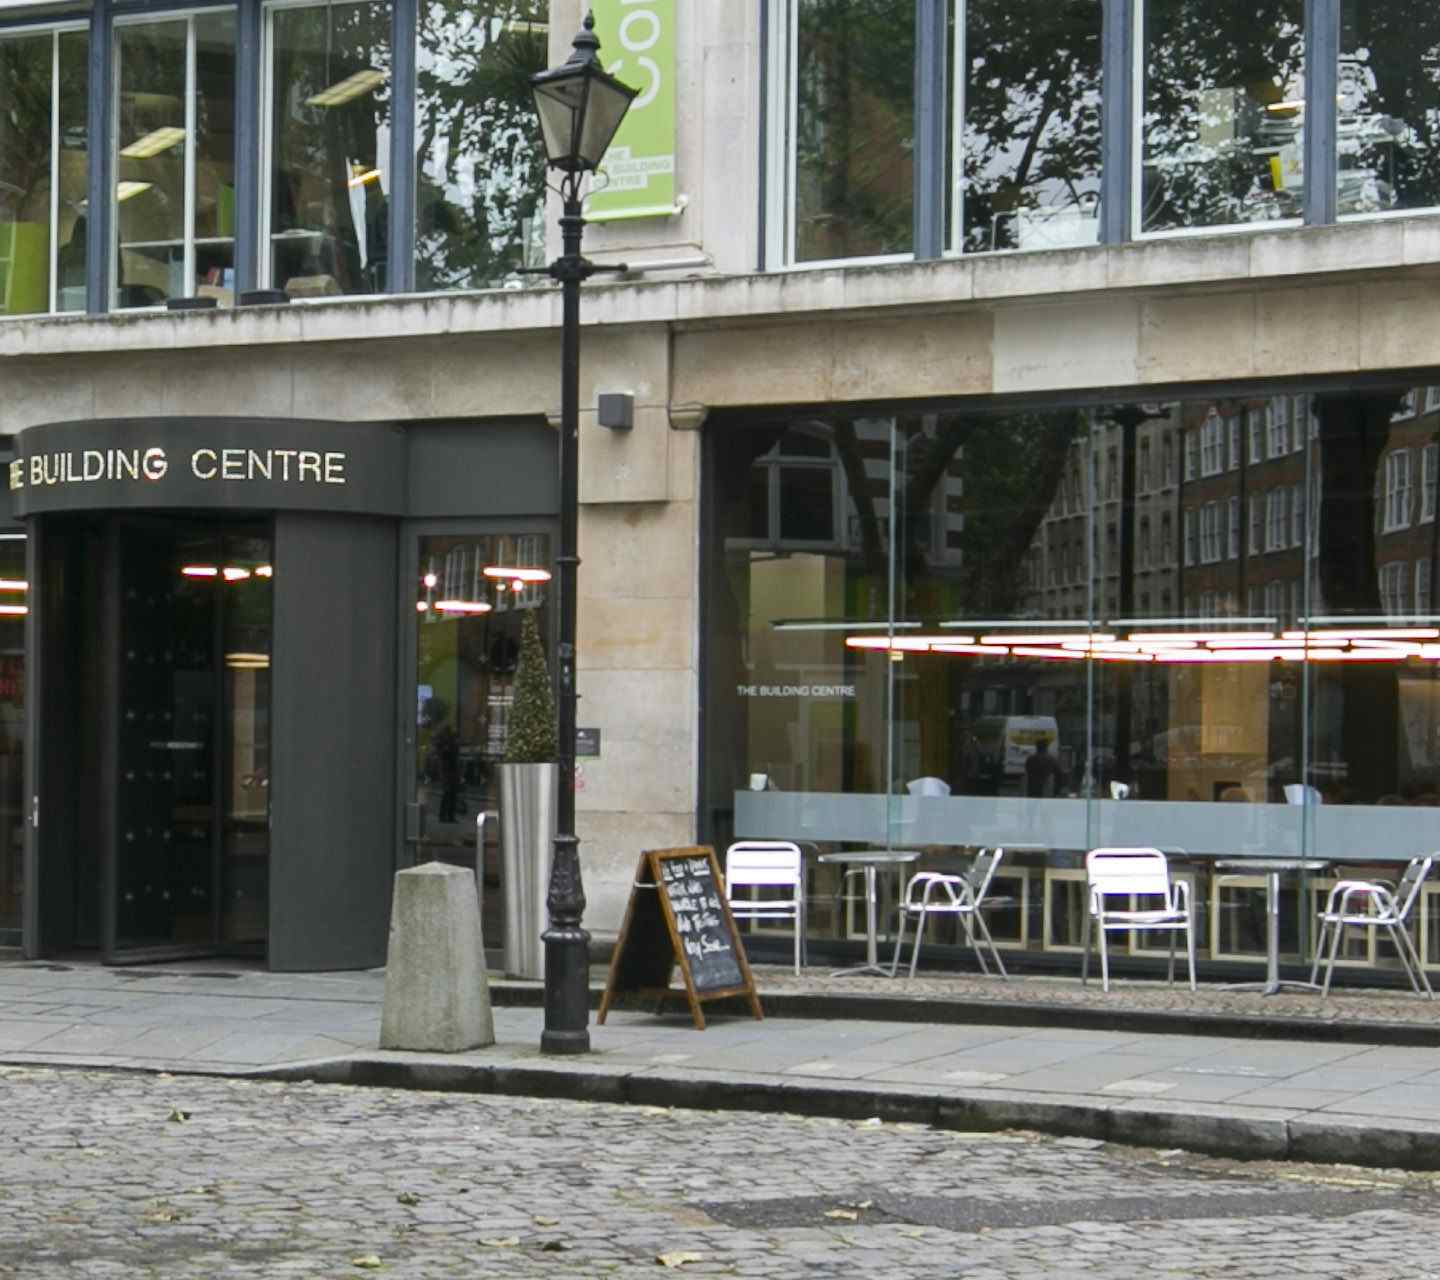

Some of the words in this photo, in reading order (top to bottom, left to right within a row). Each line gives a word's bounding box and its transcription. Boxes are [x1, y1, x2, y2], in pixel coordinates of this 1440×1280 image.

[29, 448, 169, 487] BUILDING
[191, 449, 346, 484] CENTRE
[736, 685, 758, 697] THE
[760, 685, 810, 697] BUILDING
[811, 685, 856, 697] CENTRE
